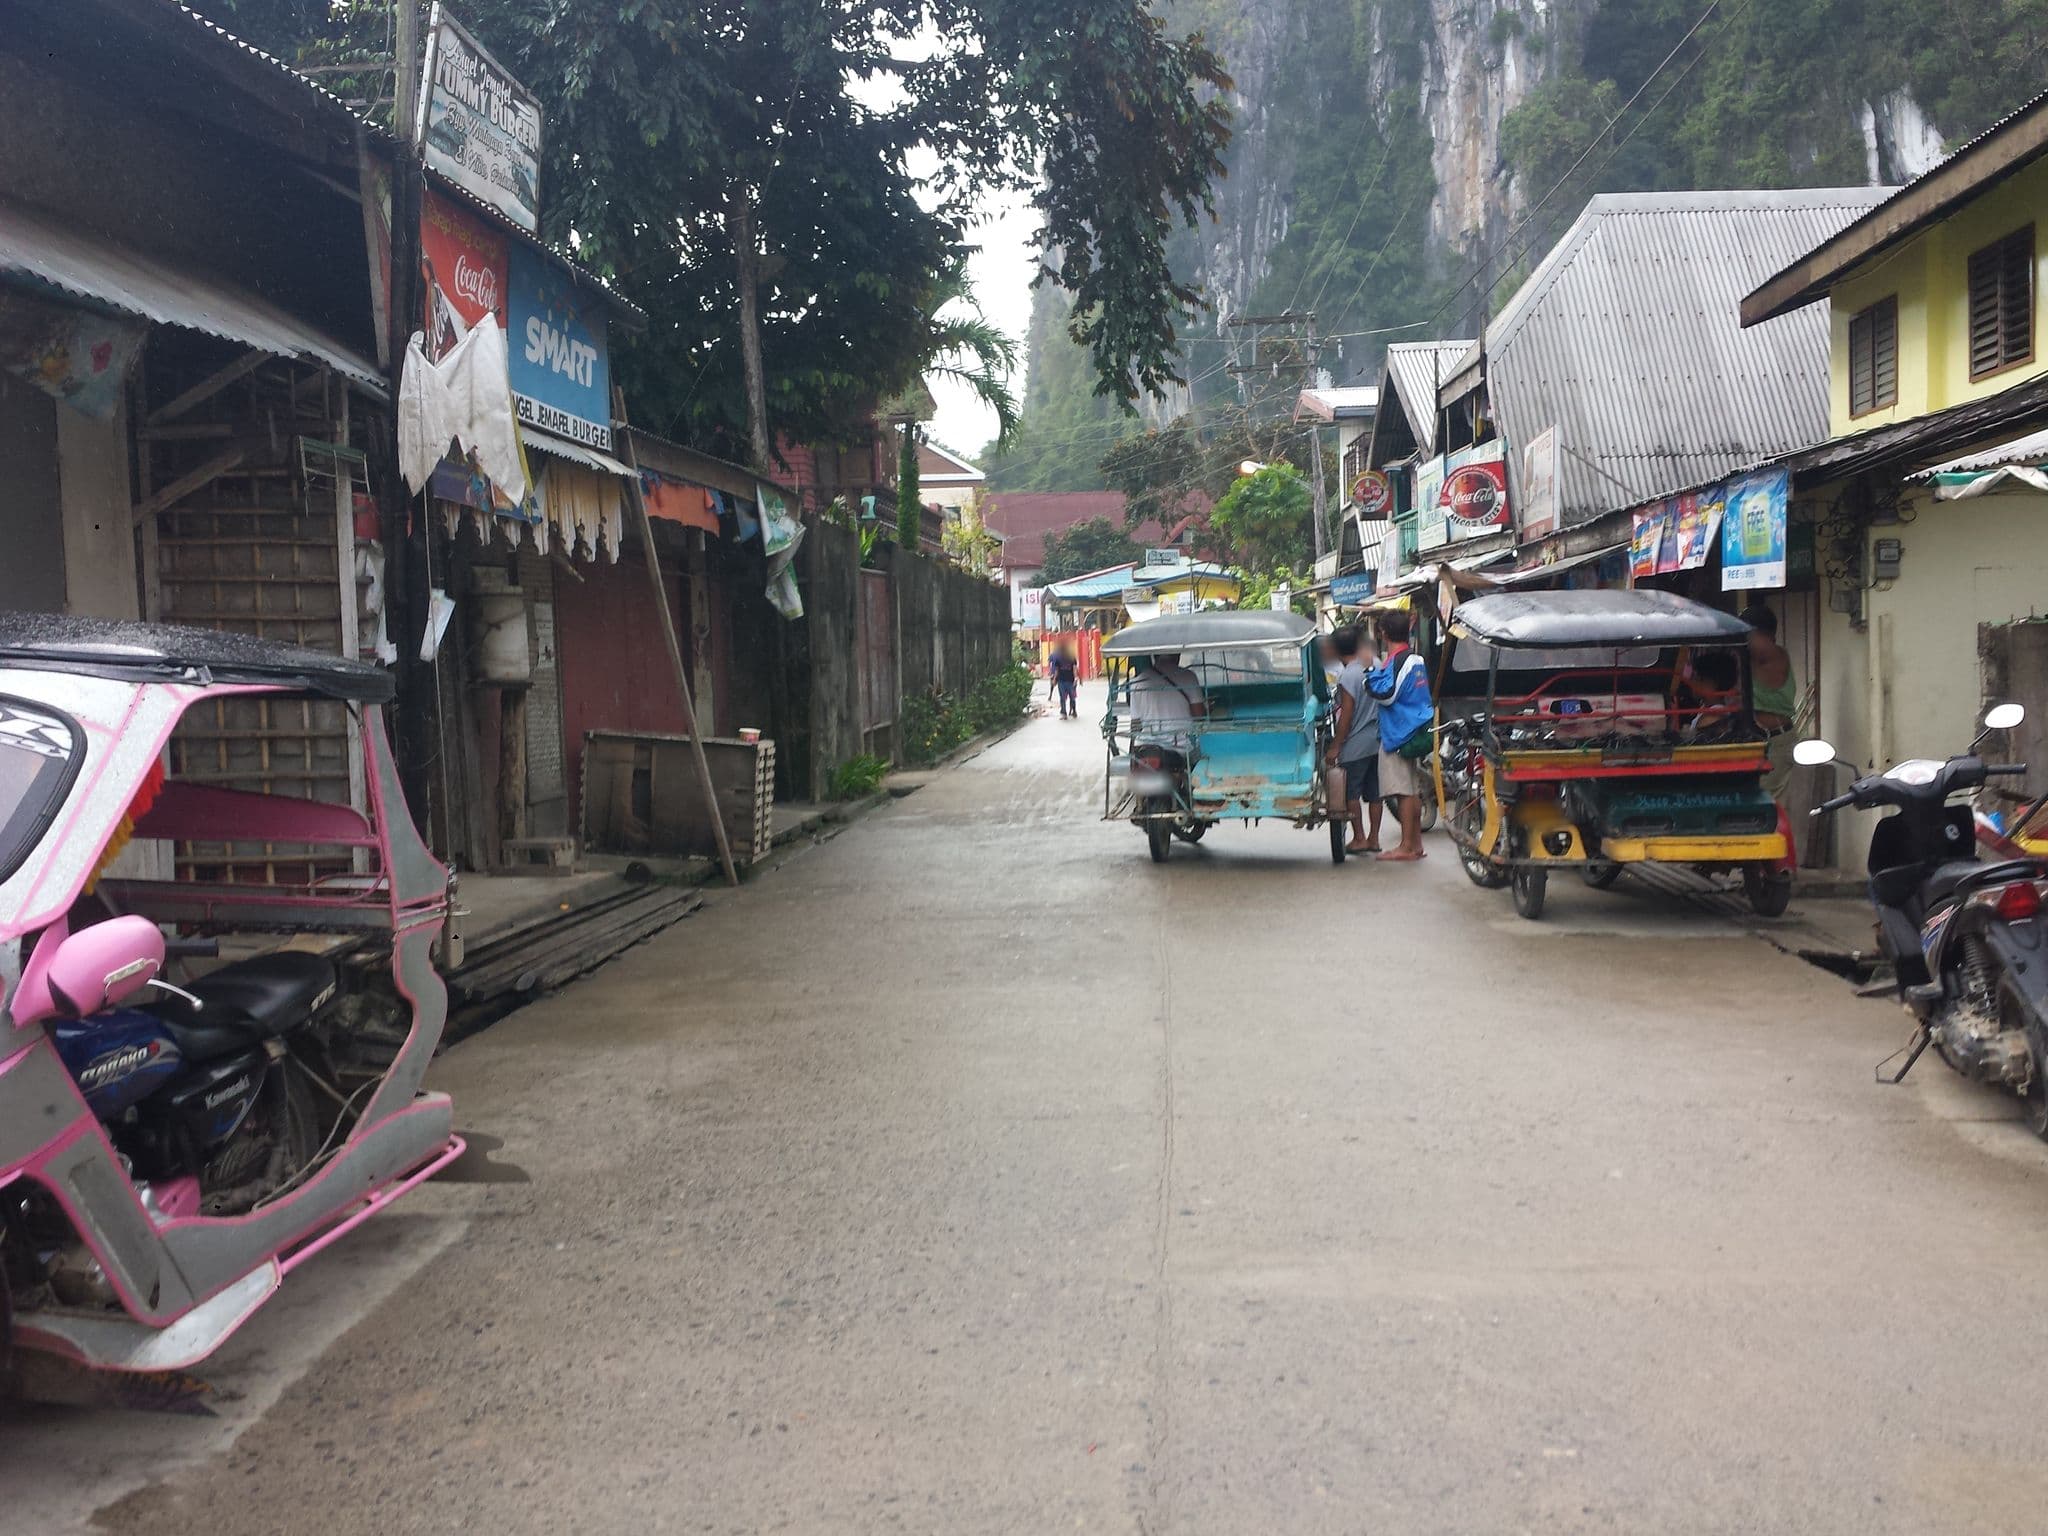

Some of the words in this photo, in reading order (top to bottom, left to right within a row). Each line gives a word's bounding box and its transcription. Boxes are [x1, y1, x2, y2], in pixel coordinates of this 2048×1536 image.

[434, 48, 488, 118] YUMMY
[490, 84, 538, 154] BURGER
[454, 254, 498, 311] Coca-Cola
[525, 315, 597, 388] SMART
